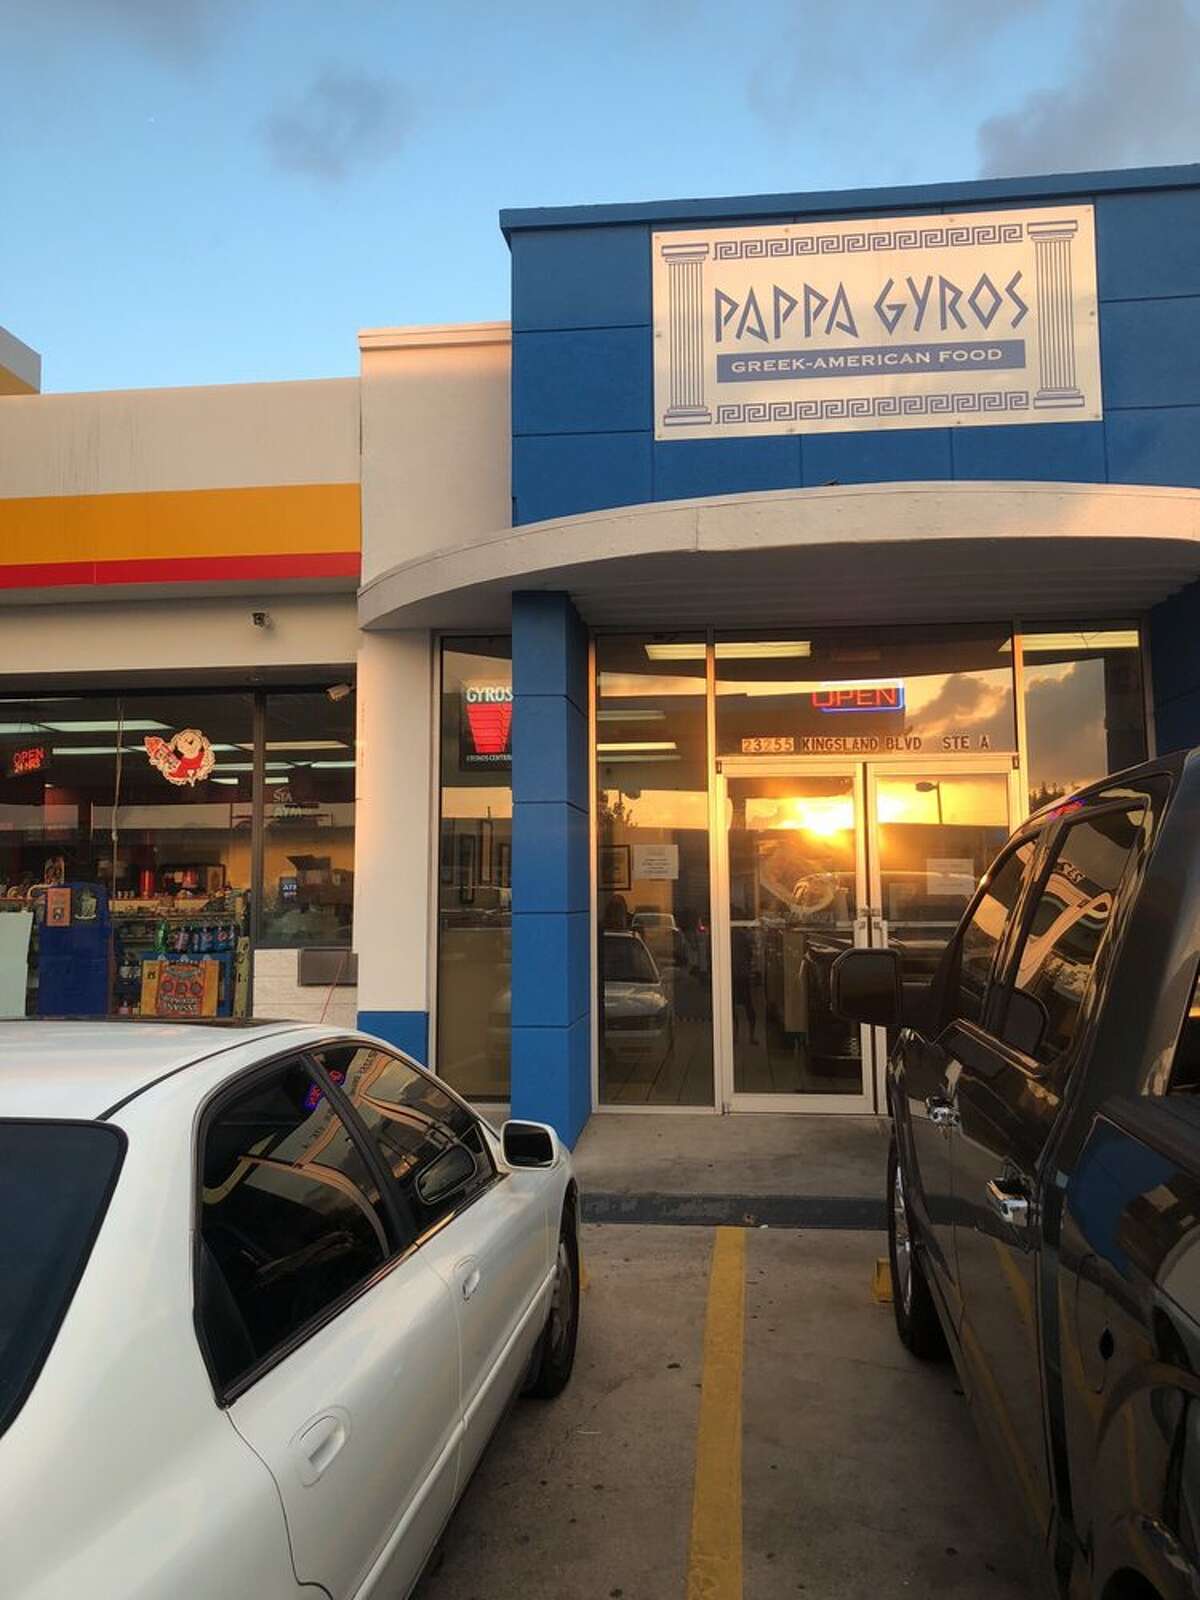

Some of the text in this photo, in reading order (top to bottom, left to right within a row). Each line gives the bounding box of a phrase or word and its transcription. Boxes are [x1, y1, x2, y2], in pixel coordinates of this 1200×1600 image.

[715, 270, 1029, 344] PAPPA GYROS
[731, 347, 1003, 374] GREEK-AMERICAN FOOD
[466, 686, 513, 703] GYROS
[811, 686, 897, 707] OPEN
[743, 735, 990, 751] 23255 KINGSLAND BLVD STE A
